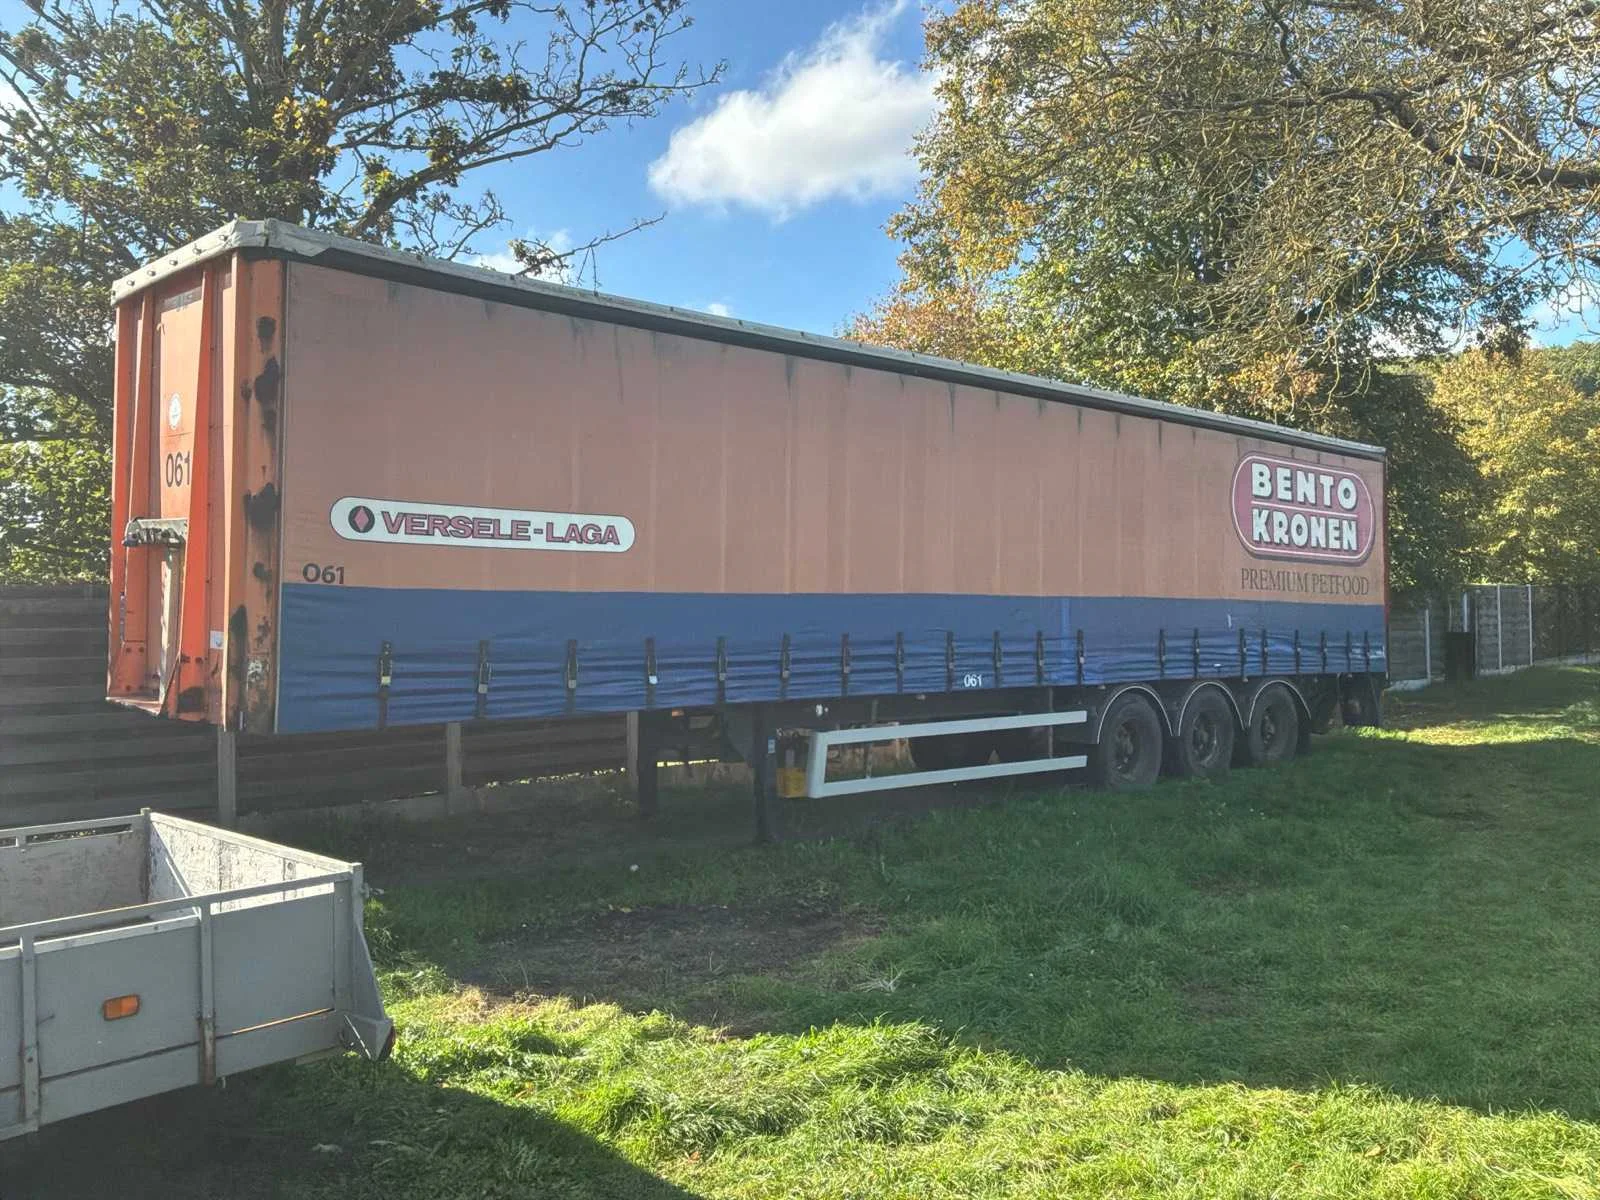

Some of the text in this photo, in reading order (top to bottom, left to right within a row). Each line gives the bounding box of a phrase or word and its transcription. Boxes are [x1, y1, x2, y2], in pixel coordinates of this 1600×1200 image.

[165, 451, 190, 487] 061
[1252, 463, 1357, 510] BENTO
[381, 510, 620, 545] VERSELE-LAGA
[1252, 508, 1358, 550] KRONEN
[1241, 568, 1369, 595] PREMIUM PETFOOD
[963, 674, 982, 687] 061
